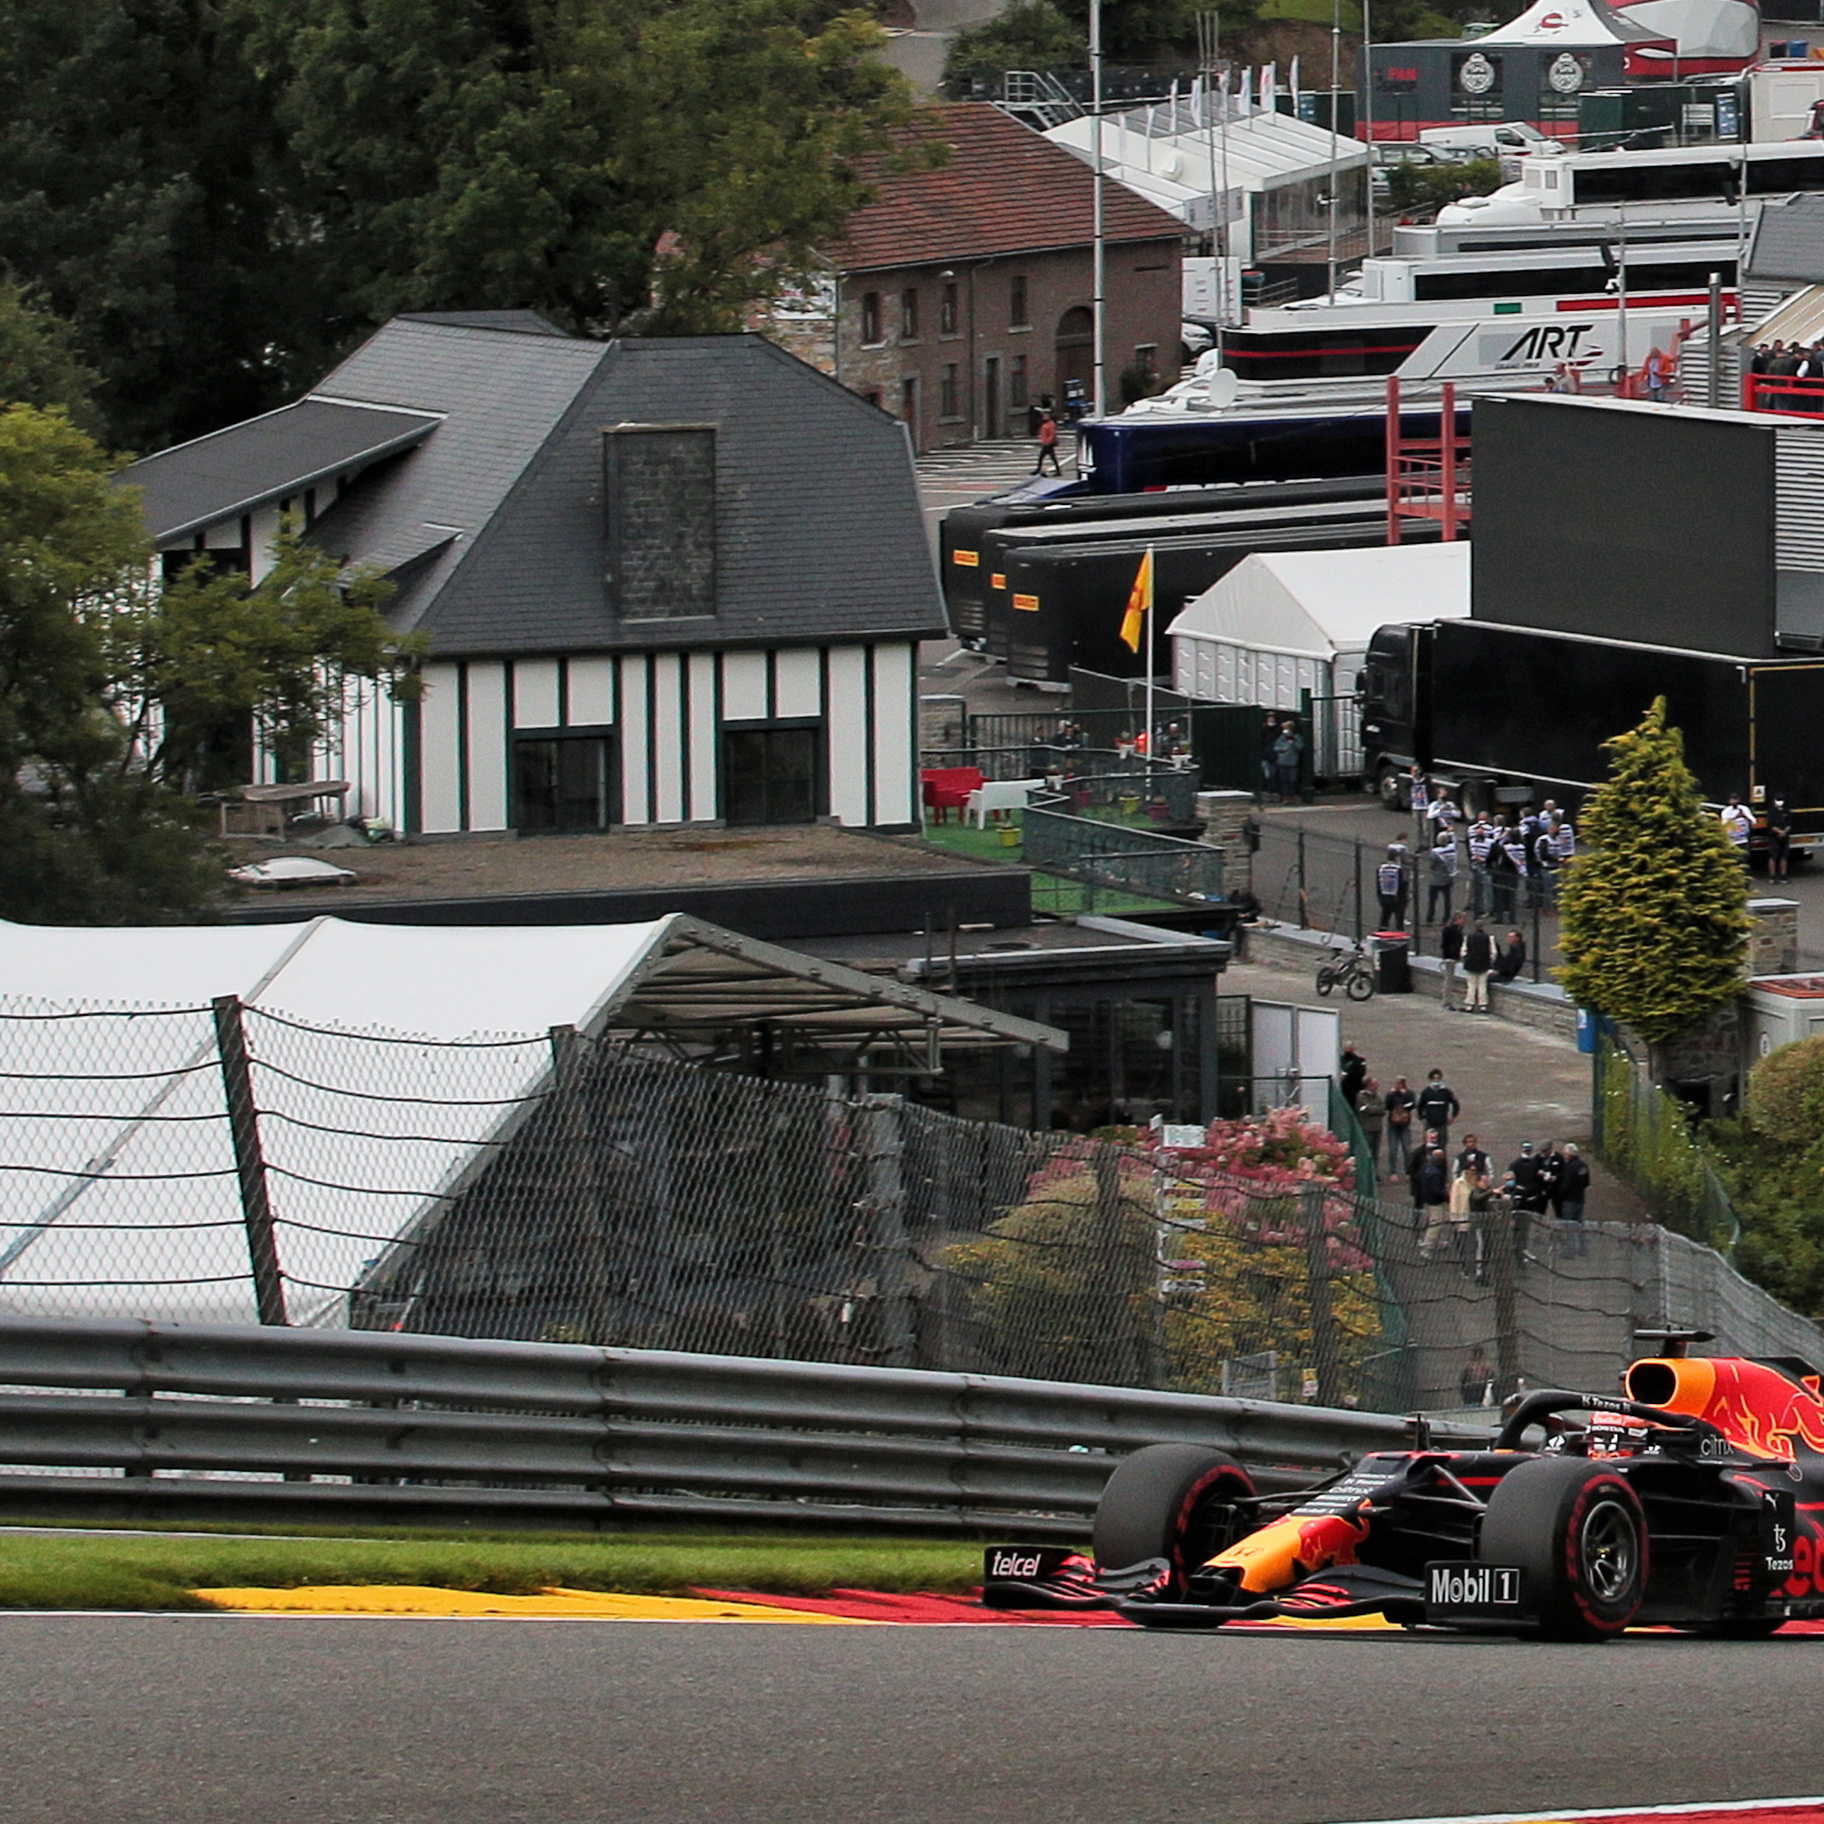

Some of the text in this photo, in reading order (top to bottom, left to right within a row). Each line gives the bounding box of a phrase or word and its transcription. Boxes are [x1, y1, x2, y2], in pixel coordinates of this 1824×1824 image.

[1500, 324, 1595, 361] ART
[1592, 1397, 1622, 1411] Tezos
[991, 1550, 1042, 1577] telcel
[1765, 1557, 1794, 1571] Tezos
[1431, 1568, 1490, 1605] Mobil
